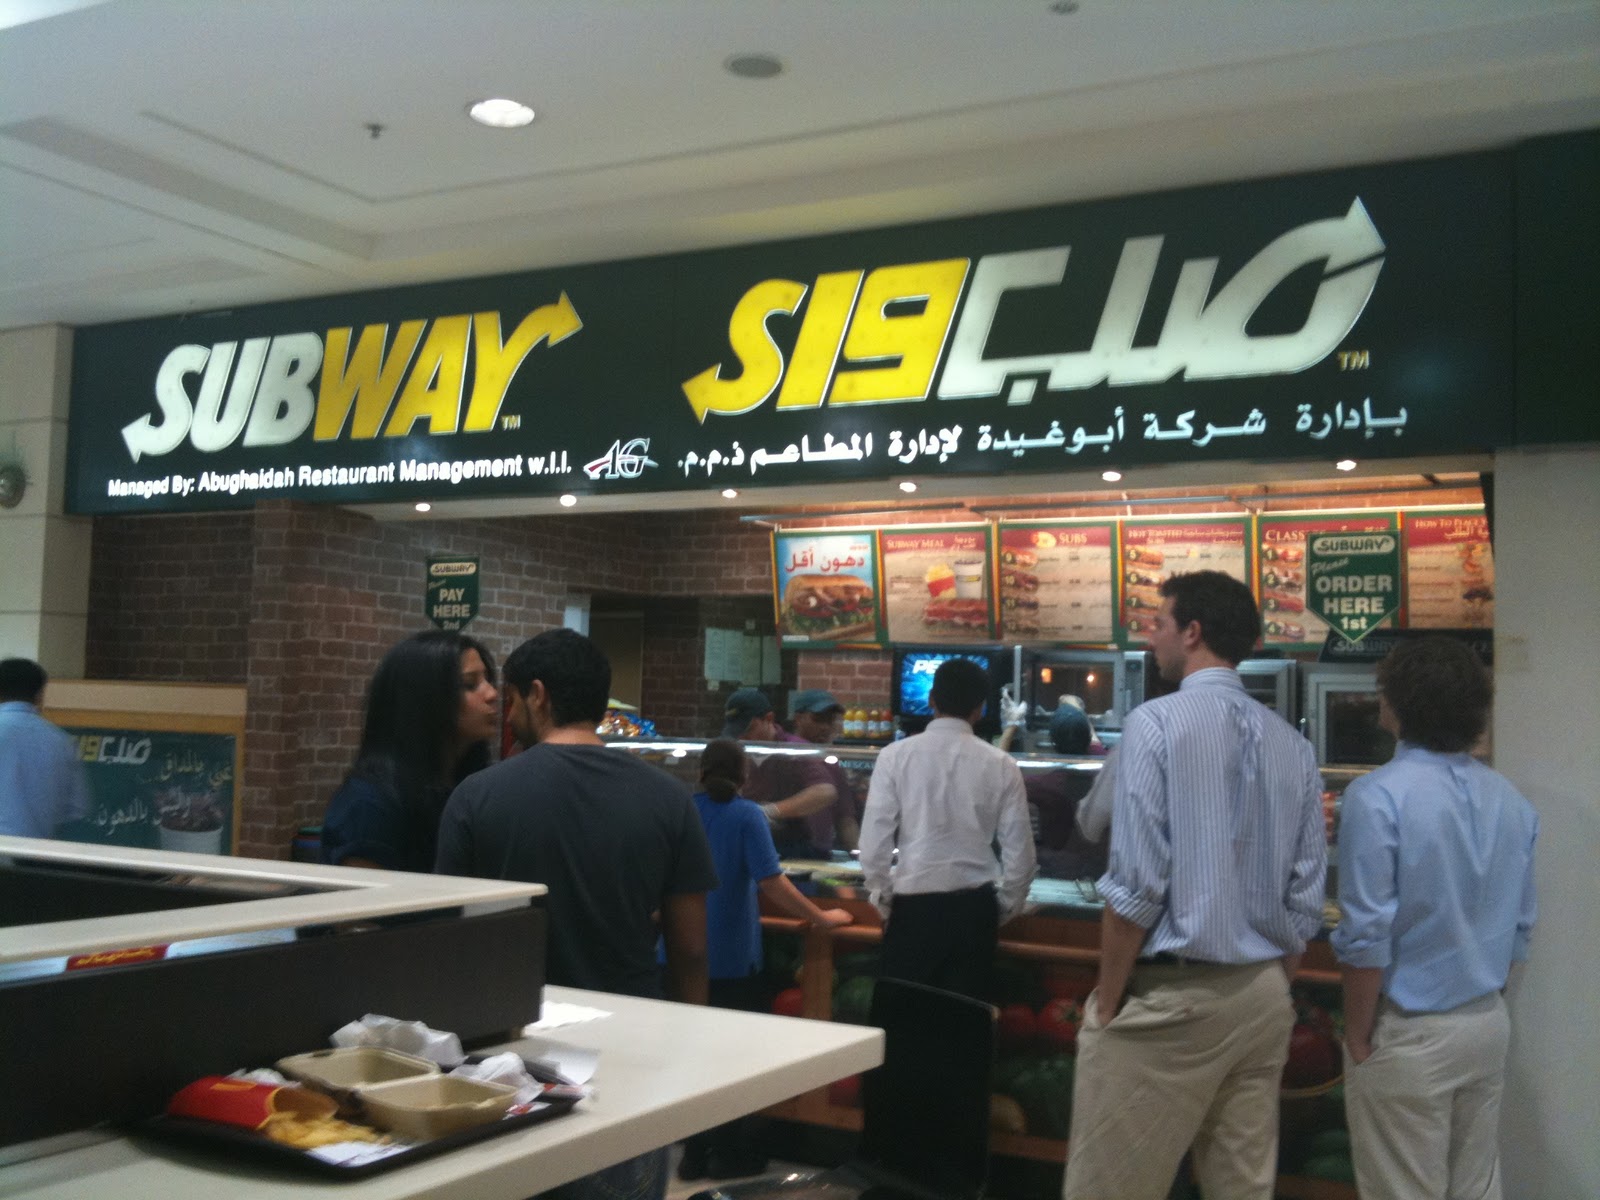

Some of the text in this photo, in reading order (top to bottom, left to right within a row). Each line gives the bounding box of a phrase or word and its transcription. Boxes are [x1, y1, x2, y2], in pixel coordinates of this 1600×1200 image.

[1339, 351, 1370, 370] TM
[121, 291, 583, 463] SUBWAY
[502, 414, 521, 430] TM
[1142, 407, 1267, 447] شركة
[750, 431, 873, 476] المطاعم
[107, 476, 170, 500] Managed
[172, 474, 195, 497] By:
[198, 466, 295, 496] Abughaidah
[298, 460, 395, 488] Restaurant
[399, 455, 524, 485] Management
[1058, 532, 1088, 544] SUBS
[1317, 537, 1390, 551] SUBWAY
[784, 545, 865, 573] دهون أقل
[433, 564, 474, 573] SUBWAY
[1315, 574, 1393, 594] ORDER
[440, 588, 465, 602] PAY
[433, 604, 471, 619] HERE
[1323, 596, 1385, 615] HERE
[442, 620, 461, 631] 2nd
[1341, 616, 1368, 630] 1st
